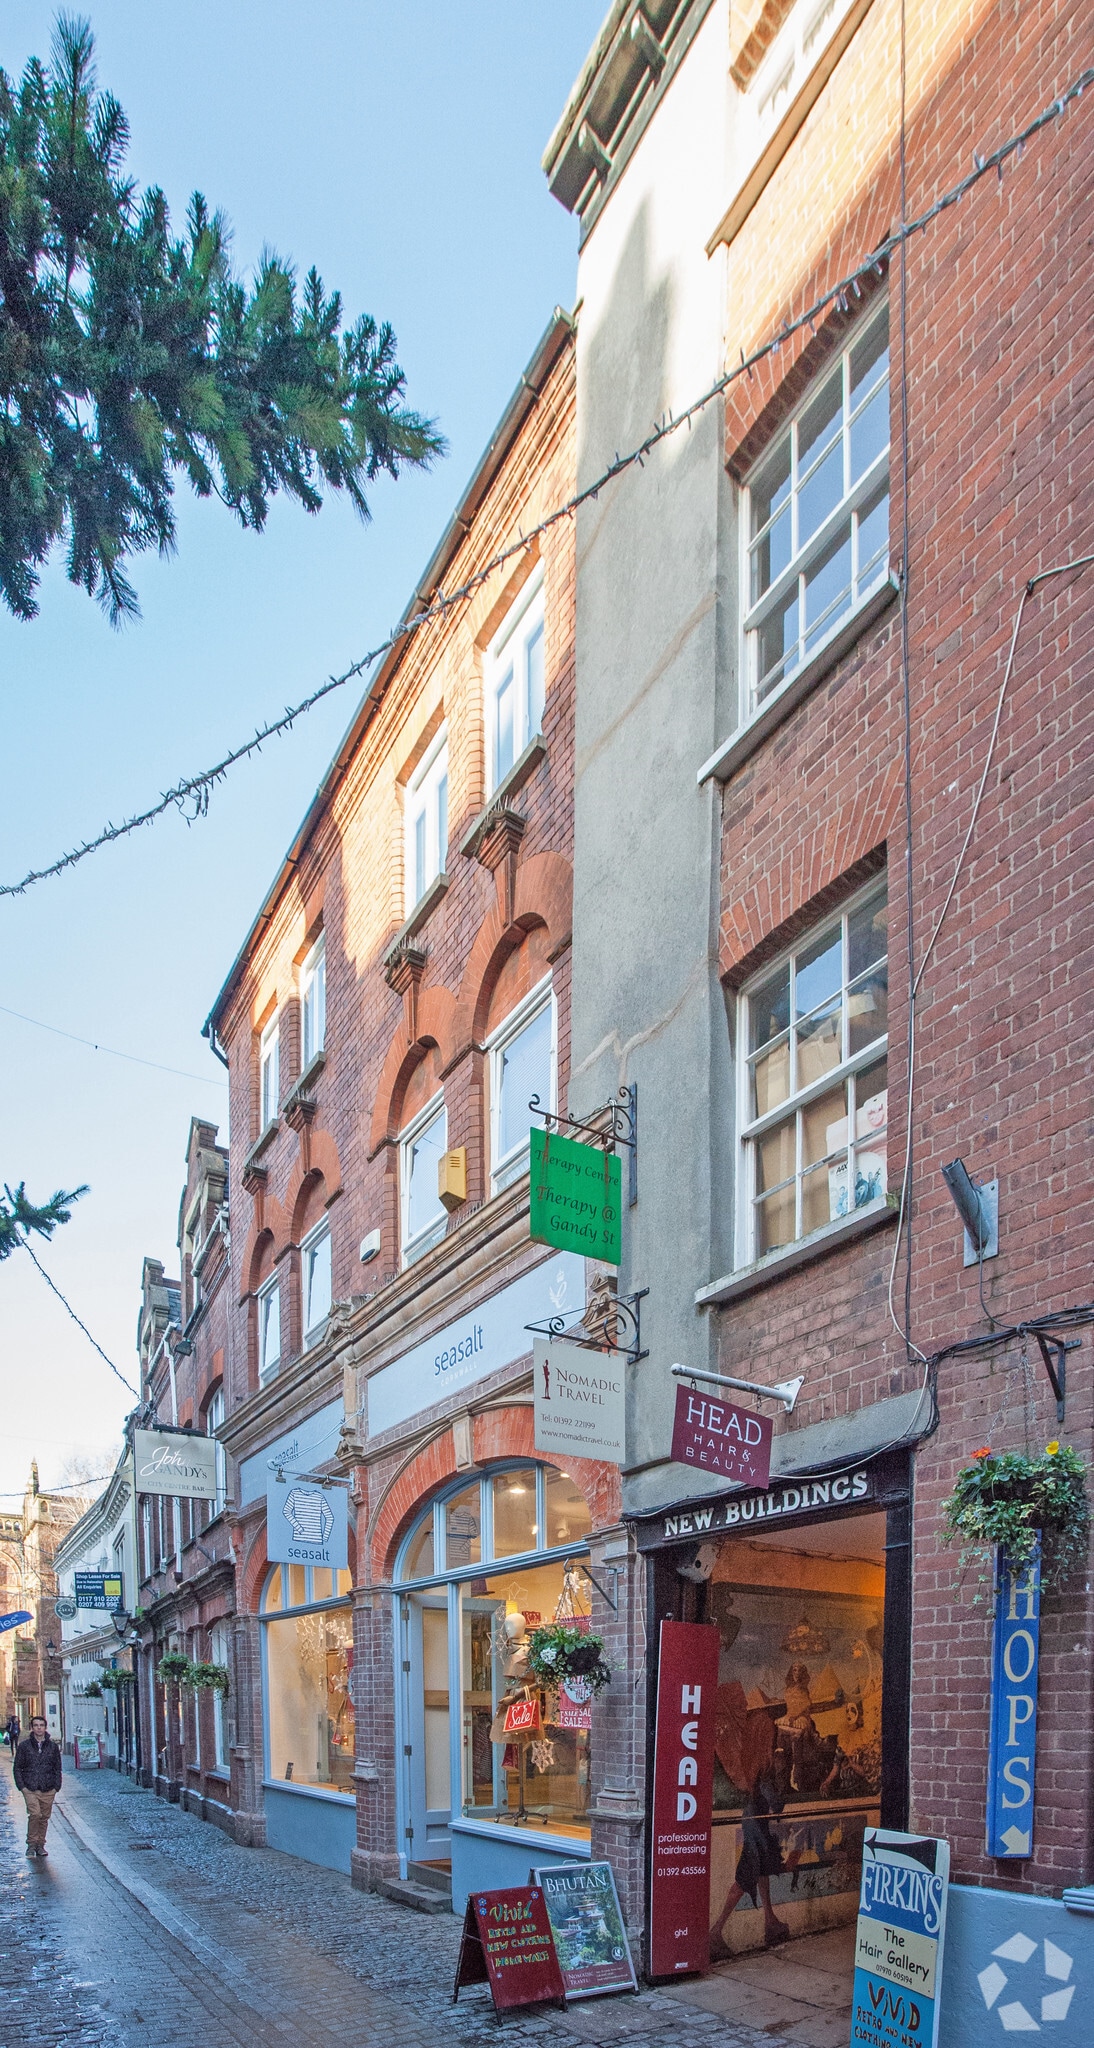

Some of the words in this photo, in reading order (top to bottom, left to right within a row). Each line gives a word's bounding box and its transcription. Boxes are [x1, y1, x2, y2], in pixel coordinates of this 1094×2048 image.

[534, 1149, 582, 1177] Therapy
[585, 1166, 619, 1187] Centre
[536, 1185, 598, 1220] Therapy
[602, 1205, 617, 1224] @
[551, 1214, 598, 1244] Gandy
[602, 1229, 615, 1245] St
[434, 1324, 484, 1376] seasalt
[555, 1367, 621, 1394] NOMADIC
[556, 1383, 605, 1406] TRAVEL
[553, 1415, 573, 1427] 01392
[686, 1396, 762, 1446] HEAD
[693, 1432, 737, 1457] HAIR
[742, 1448, 752, 1463] &
[685, 1445, 757, 1478] BEAUTY
[725, 1470, 869, 1526] BUILDINGS
[287, 1547, 330, 1562] seasalt
[1002, 1537, 1038, 1809] HOPS
[508, 1708, 531, 1729] Sale
[563, 1716, 583, 1728] SALE
[579, 1707, 592, 1717] SAL
[676, 1683, 702, 1822] HEAD
[657, 1831, 708, 1845] professional
[657, 1844, 707, 1856] hairdressing
[545, 1874, 607, 1893] BHUTAN
[657, 1867, 680, 1877] 01392
[681, 1866, 707, 1875] 435566
[859, 1859, 943, 1934] FIRKINS
[674, 1926, 689, 1939] ghd
[883, 1927, 905, 1948] The
[486, 1940, 509, 1953] NEW
[859, 1938, 883, 1959] Hair
[886, 1950, 930, 1982] Gallery
[856, 2005, 883, 2031] RETRO
